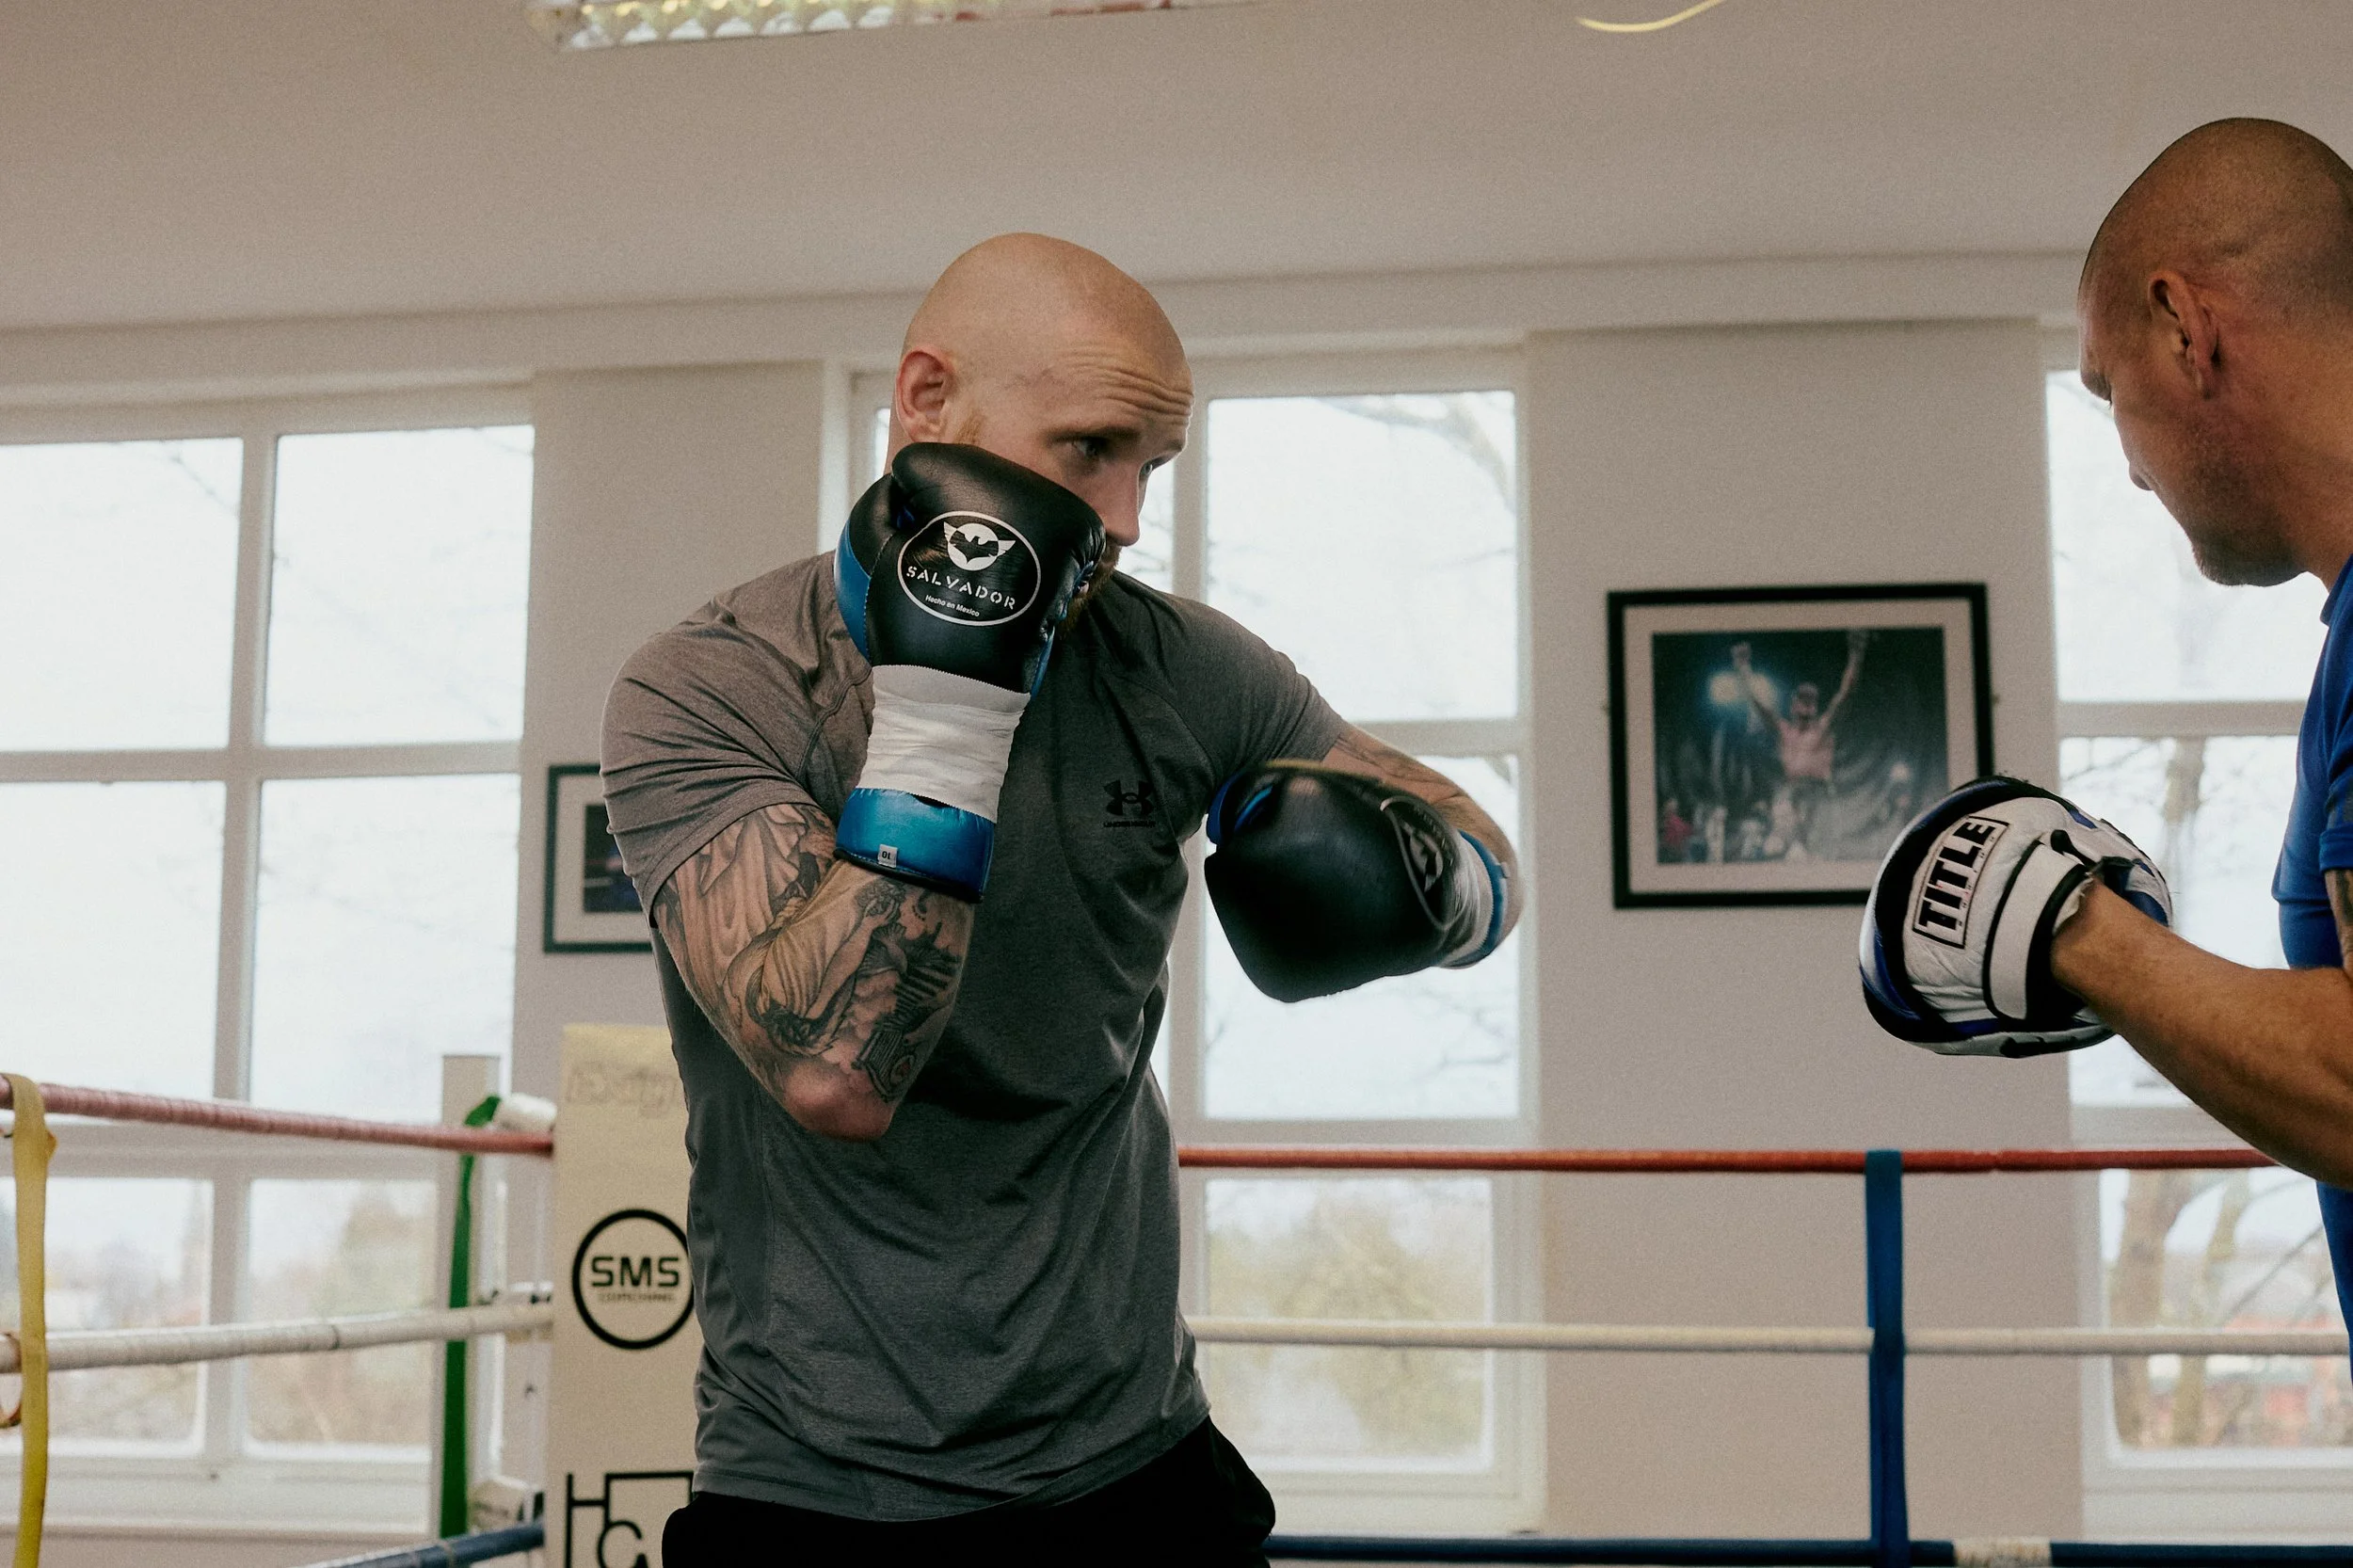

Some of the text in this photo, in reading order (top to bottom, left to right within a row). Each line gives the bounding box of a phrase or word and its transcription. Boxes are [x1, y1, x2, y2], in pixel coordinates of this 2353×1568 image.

[907, 566, 1016, 610] SALVADOR
[925, 594, 946, 606] Hecho
[956, 603, 980, 617] Mexico
[1919, 823, 1996, 930] TITLE
[591, 1256, 680, 1287] SMS
